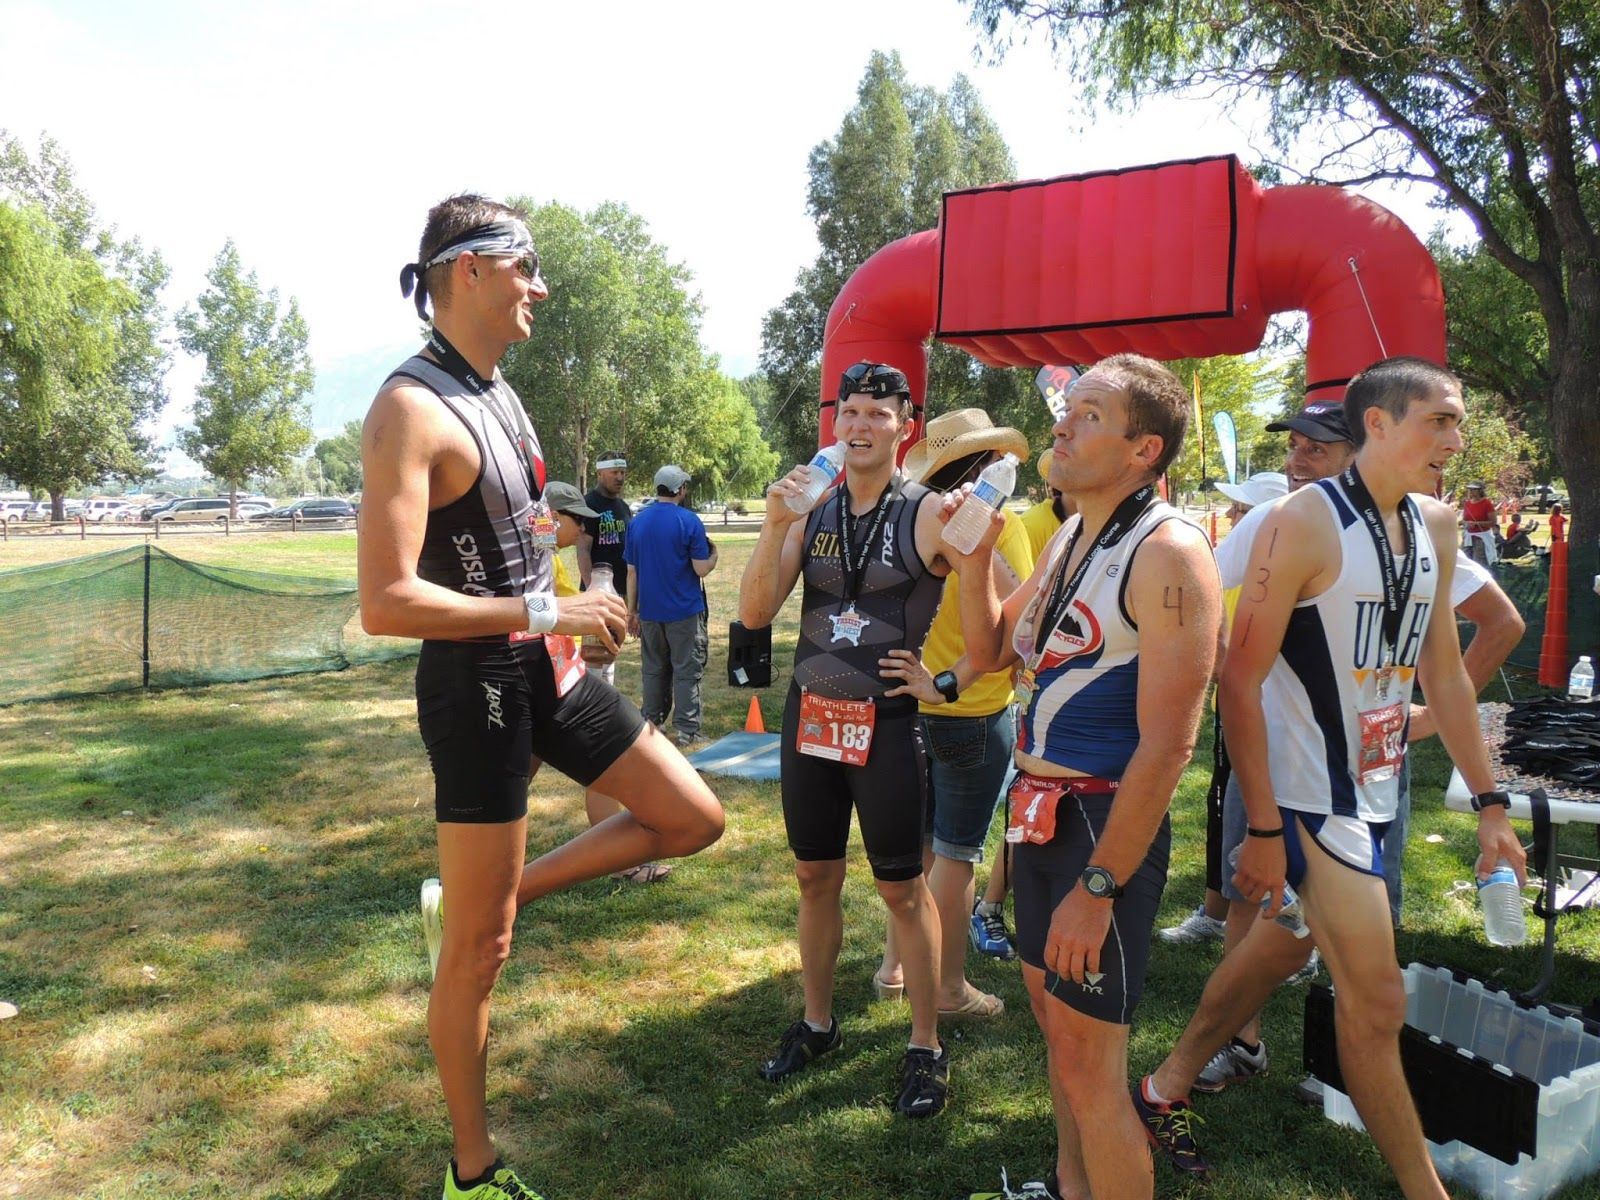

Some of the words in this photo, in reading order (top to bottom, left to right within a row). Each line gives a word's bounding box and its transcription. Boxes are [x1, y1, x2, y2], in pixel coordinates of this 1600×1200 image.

[1364, 508, 1377, 528] Utah
[1088, 545, 1103, 561] Long
[1100, 522, 1121, 545] Course
[1374, 523, 1385, 541] Half
[1380, 538, 1391, 569] Triathlon
[1385, 568, 1394, 587] Long
[1163, 586, 1183, 627] 4
[1388, 586, 1397, 611] Course
[808, 695, 867, 712] TRIATHLETE
[829, 721, 871, 751] 183
